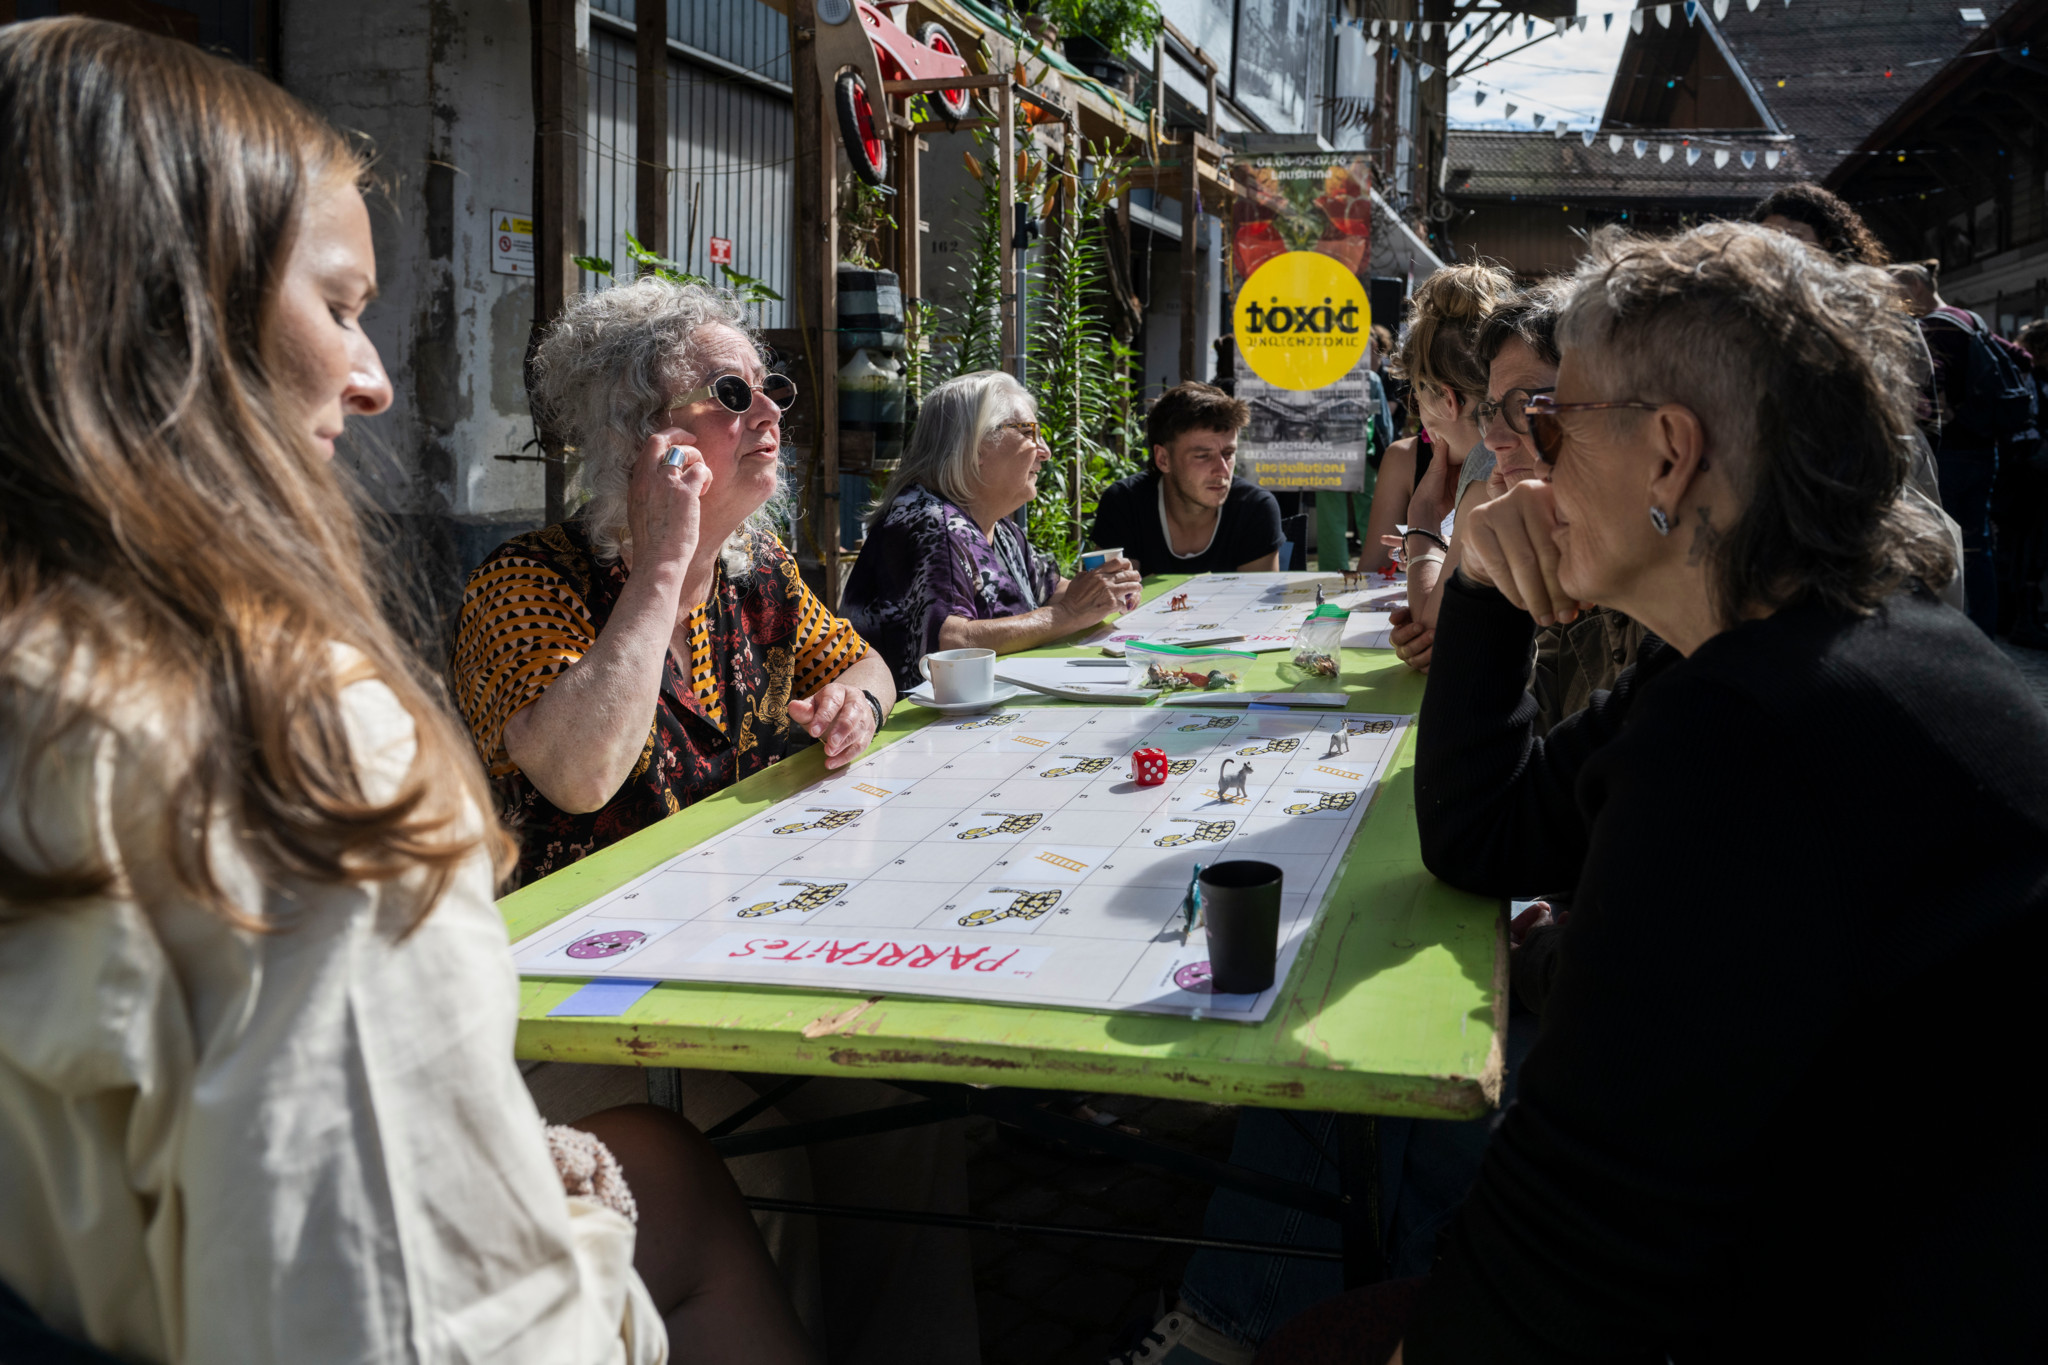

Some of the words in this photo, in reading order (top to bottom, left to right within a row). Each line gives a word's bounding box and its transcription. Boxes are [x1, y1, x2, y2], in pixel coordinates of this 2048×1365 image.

[1271, 169, 1333, 181] Lausanne
[931, 240, 958, 254] 162
[1244, 296, 1360, 334] toxic
[1279, 461, 1346, 475] pollutions
[1277, 475, 1343, 488] questions
